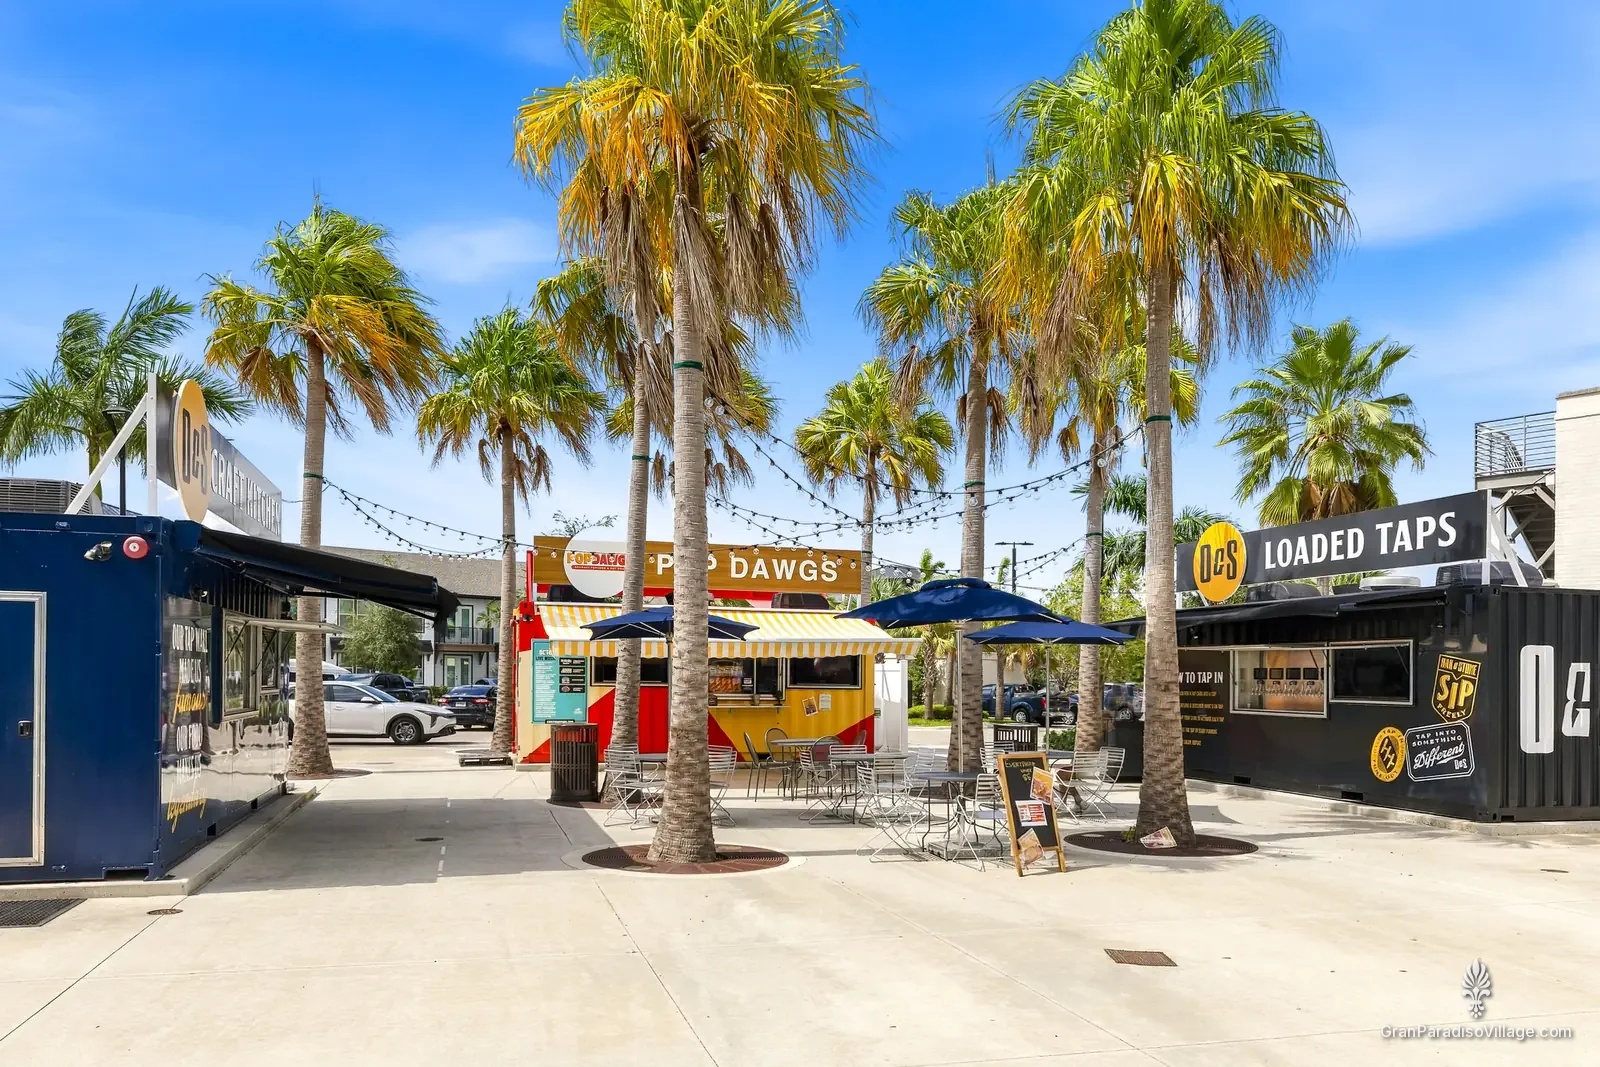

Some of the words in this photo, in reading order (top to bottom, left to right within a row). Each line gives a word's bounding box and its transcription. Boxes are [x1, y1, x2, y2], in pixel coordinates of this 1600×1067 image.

[211, 449, 245, 511] CRAFT
[247, 477, 280, 535] KITCHEN
[1265, 527, 1365, 570] LOADED
[1375, 511, 1457, 555] TAPS
[567, 552, 626, 566] POPDAWG
[731, 557, 838, 582] DAWGS
[172, 623, 184, 651] OUR
[185, 625, 195, 652] TAP
[179, 658, 194, 684] MADE
[194, 659, 202, 683] US
[1185, 671, 1196, 684] TO
[1197, 671, 1213, 684] TAP
[1214, 671, 1224, 684] IN
[1436, 674, 1474, 710] SIP
[1436, 703, 1467, 719] FREELY
[176, 725, 188, 752] OUR
[188, 723, 203, 751] FOOD
[1412, 734, 1462, 748] SOMETHING
[1415, 732, 1431, 740] TAP
[1435, 729, 1457, 737] INTO
[1413, 741, 1466, 770] Different
